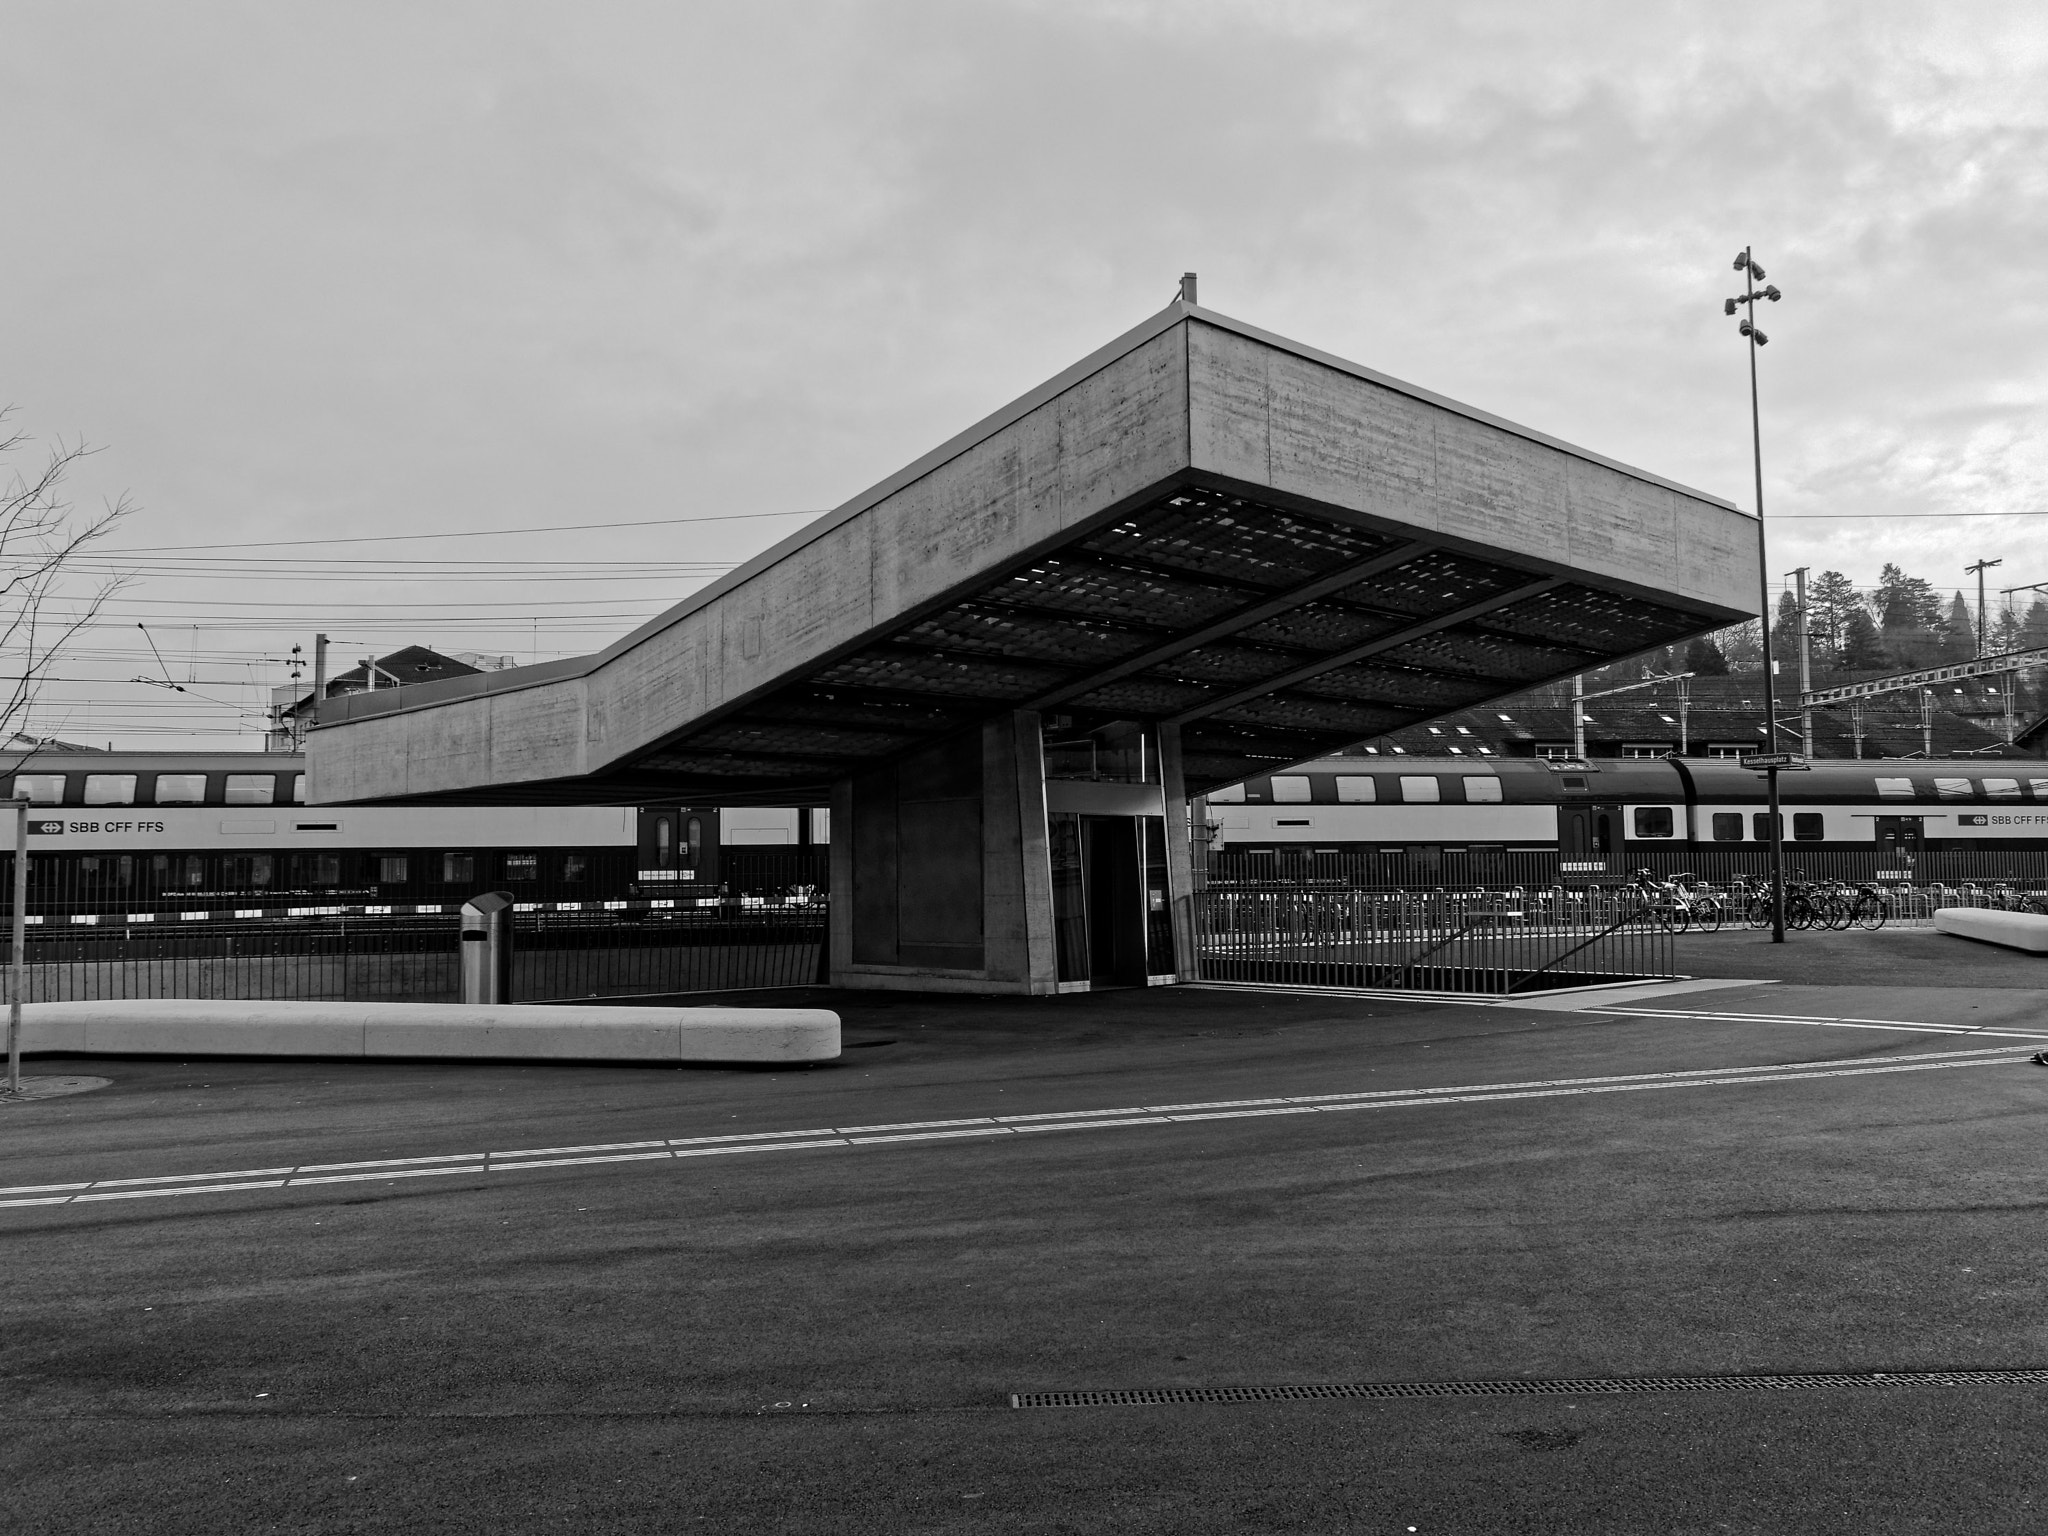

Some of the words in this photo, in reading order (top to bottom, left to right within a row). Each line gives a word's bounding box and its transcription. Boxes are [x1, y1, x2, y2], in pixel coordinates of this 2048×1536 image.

[1743, 756, 1787, 765] Kesselhausplatz
[1991, 815, 2012, 825] SBB
[2013, 815, 2033, 825] CFF
[69, 821, 100, 833] SBB
[104, 821, 133, 833] CFF
[137, 821, 164, 833] FFS
